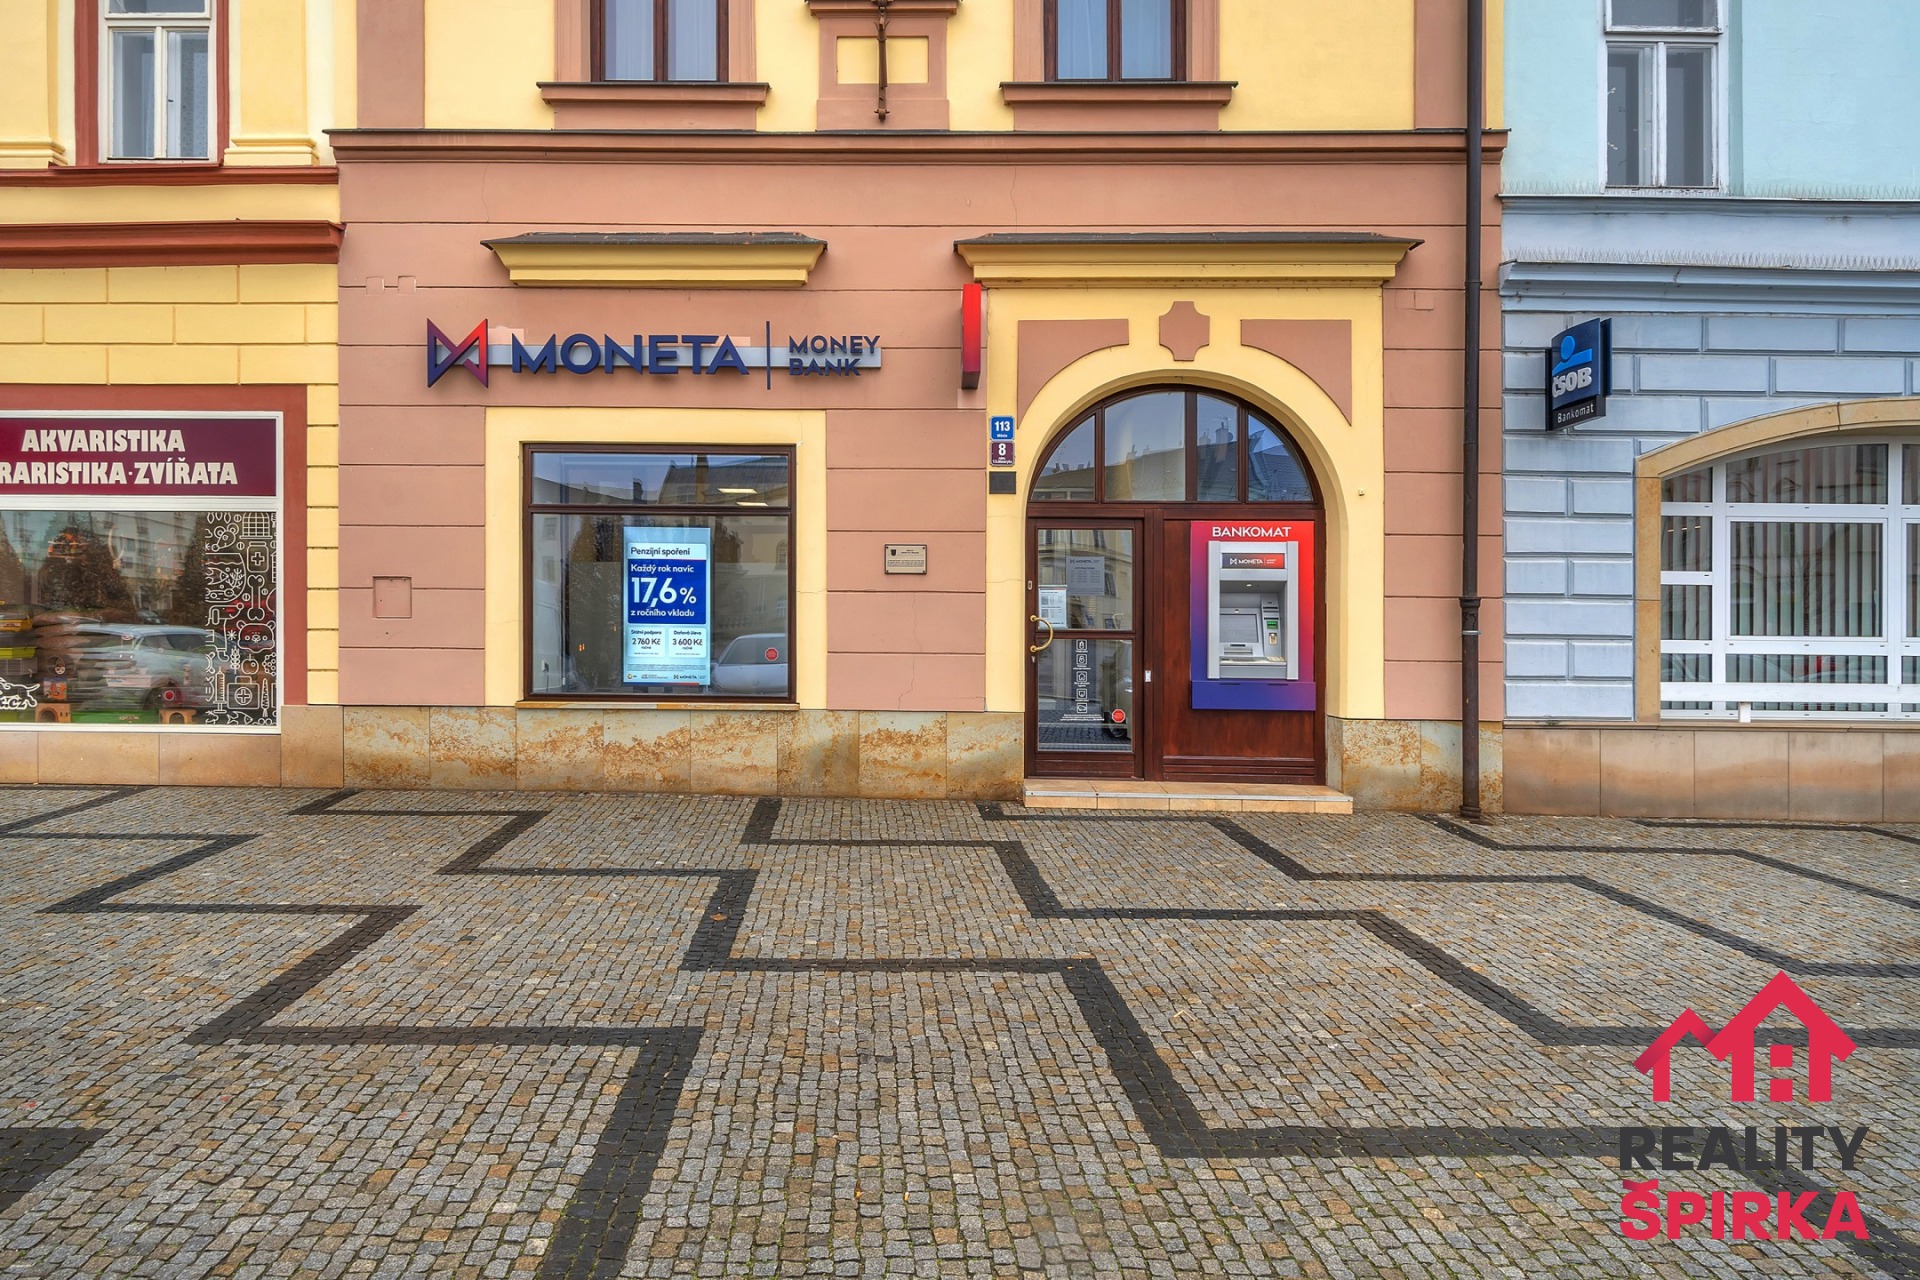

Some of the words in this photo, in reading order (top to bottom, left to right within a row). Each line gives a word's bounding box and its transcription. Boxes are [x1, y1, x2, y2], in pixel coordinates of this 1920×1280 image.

[789, 334, 880, 354] MONEY
[511, 332, 750, 375] MONETA
[789, 358, 861, 376] BANK
[1552, 367, 1592, 398] ČSOB
[1557, 402, 1594, 423] Bankomat
[995, 421, 1011, 432] 113
[21, 429, 185, 452] AKVARISTIKA
[998, 443, 1006, 456] 8
[1212, 526, 1292, 537] BANKOMAT
[631, 547, 661, 557] Penzijní
[662, 547, 690, 557] spoření
[631, 564, 656, 574] Každý
[658, 564, 671, 572] rok
[672, 564, 694, 573] navíc
[637, 608, 666, 617] ročního
[667, 608, 695, 617] vkladu
[651, 637, 661, 645] Kč
